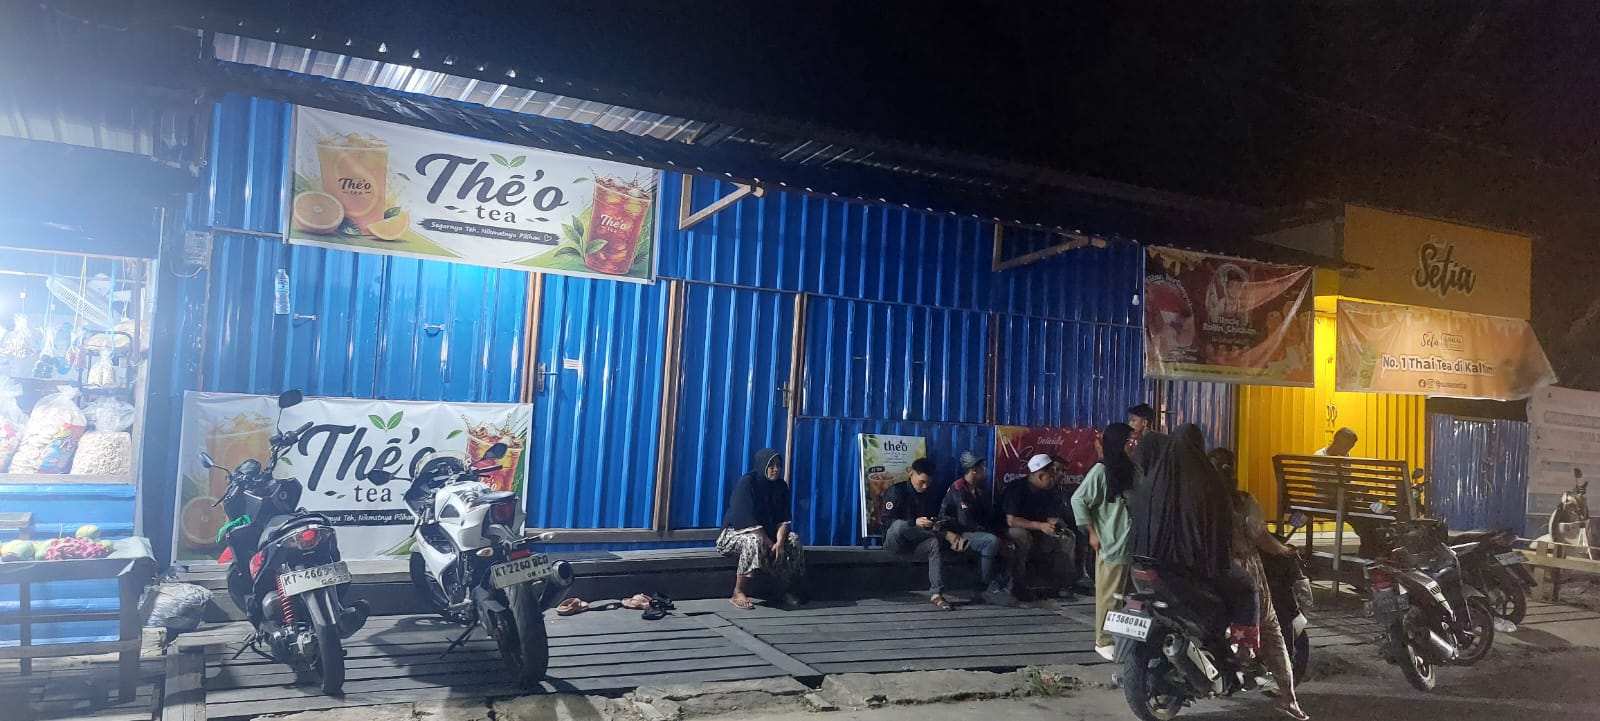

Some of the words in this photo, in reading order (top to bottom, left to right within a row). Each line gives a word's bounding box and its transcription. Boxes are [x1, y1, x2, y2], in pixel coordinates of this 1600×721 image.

[475, 205, 516, 223] tea
[1414, 242, 1477, 297] Setia
[1382, 356, 1399, 369] No.
[1401, 357, 1407, 369] 1
[1409, 357, 1435, 370] Thai
[1437, 359, 1452, 371] Tea
[1454, 360, 1463, 372] di
[353, 484, 392, 502] tea
[358, 514, 392, 523] Nikmatnya
[494, 566, 506, 577] KT
